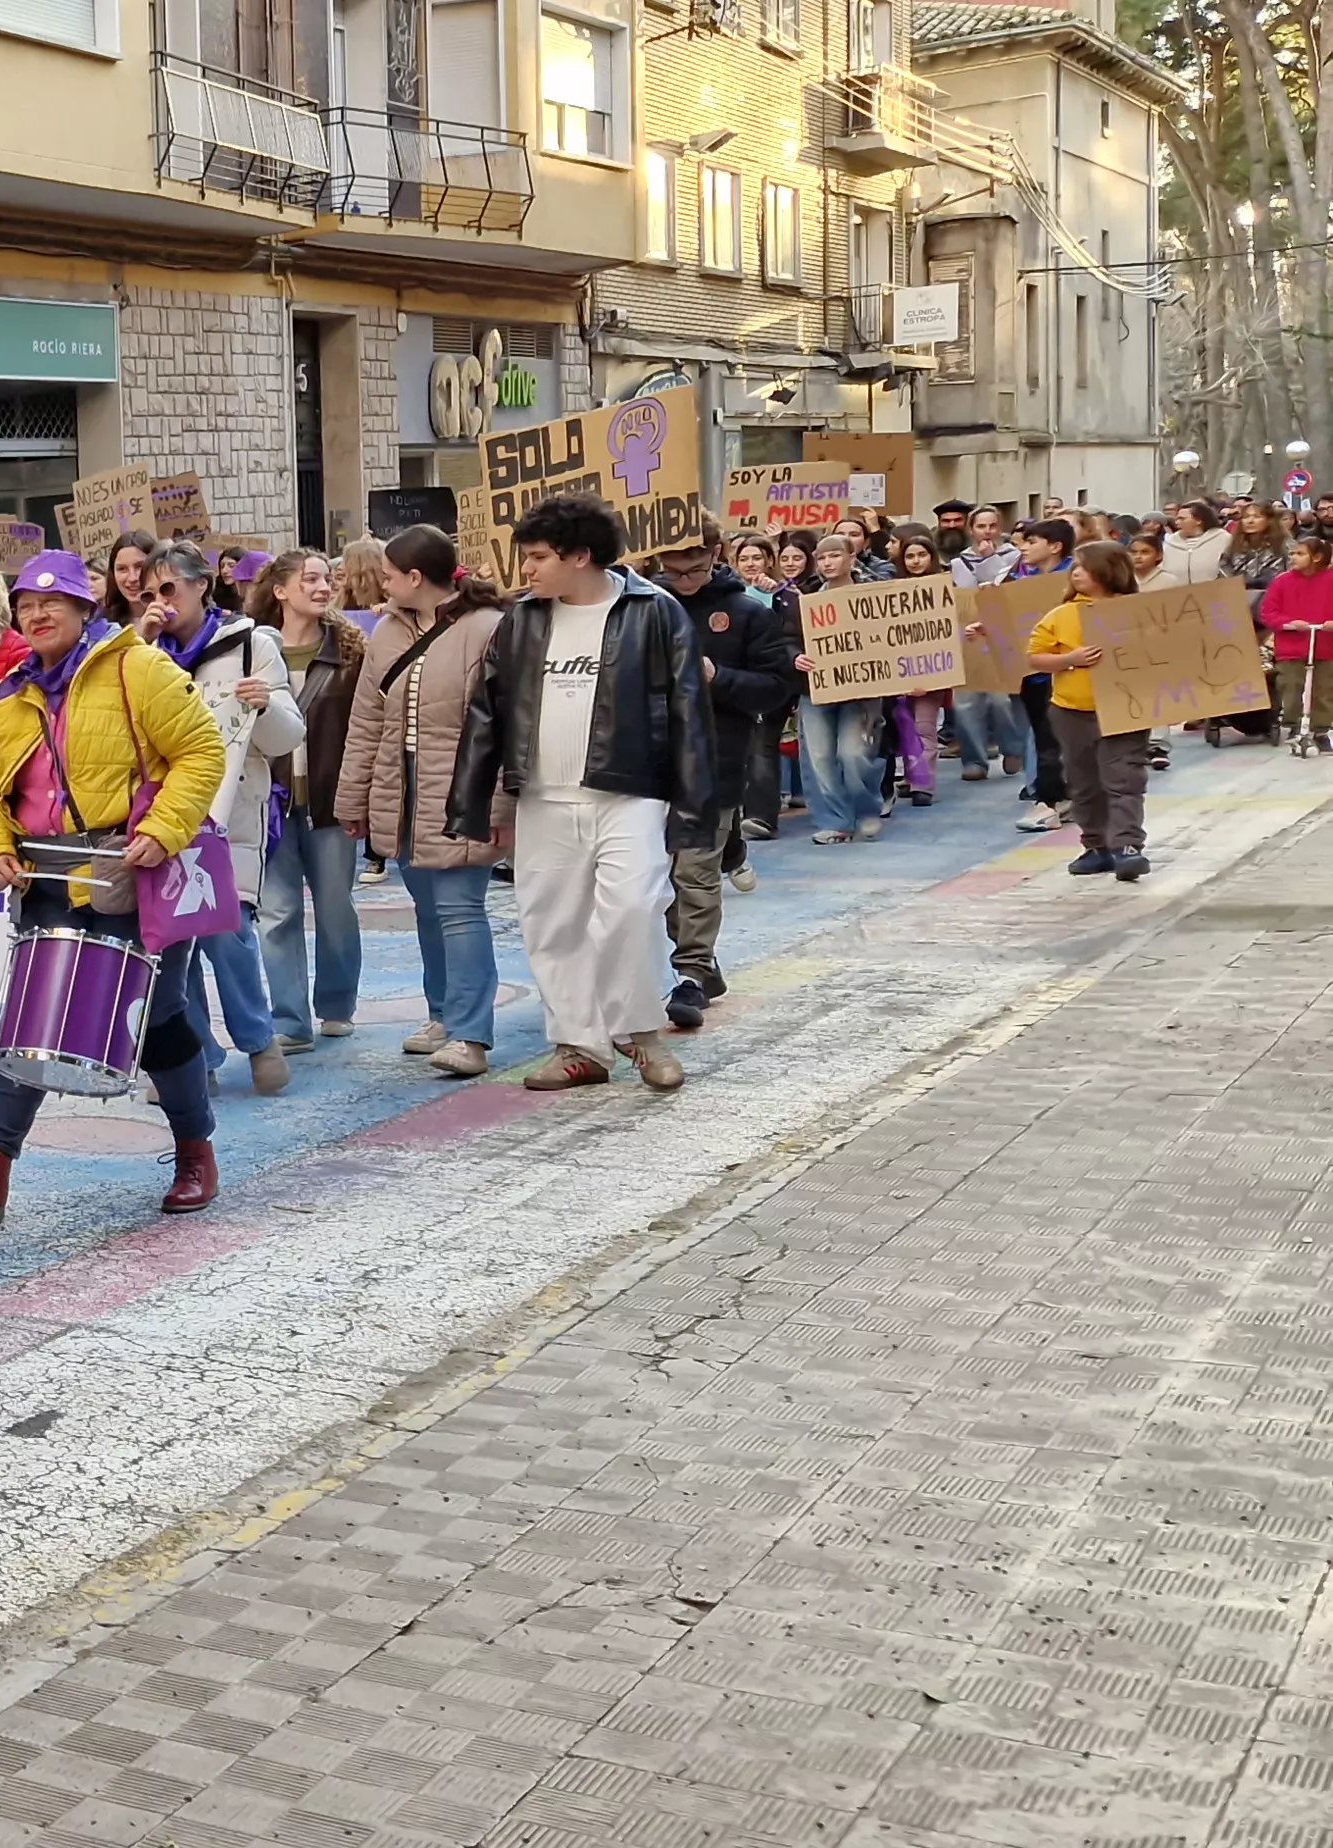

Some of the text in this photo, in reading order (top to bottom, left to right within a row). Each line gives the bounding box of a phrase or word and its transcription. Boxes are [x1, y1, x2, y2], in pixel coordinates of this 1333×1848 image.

[71, 341, 103, 356] RIERA
[502, 358, 537, 408] drive
[485, 418, 585, 490] SOLO
[76, 487, 92, 508] NO
[93, 480, 110, 503] ES
[111, 476, 125, 496] UN
[729, 467, 792, 486] SOY LA
[740, 515, 758, 528] LA
[767, 503, 841, 527] MUSA
[809, 584, 954, 628] NO VOLVERÁN A
[812, 617, 952, 656] TENER LA COMODIDAD
[812, 649, 953, 690] DE NUESTRO SILENCIO
[1113, 646, 1169, 671] EL
